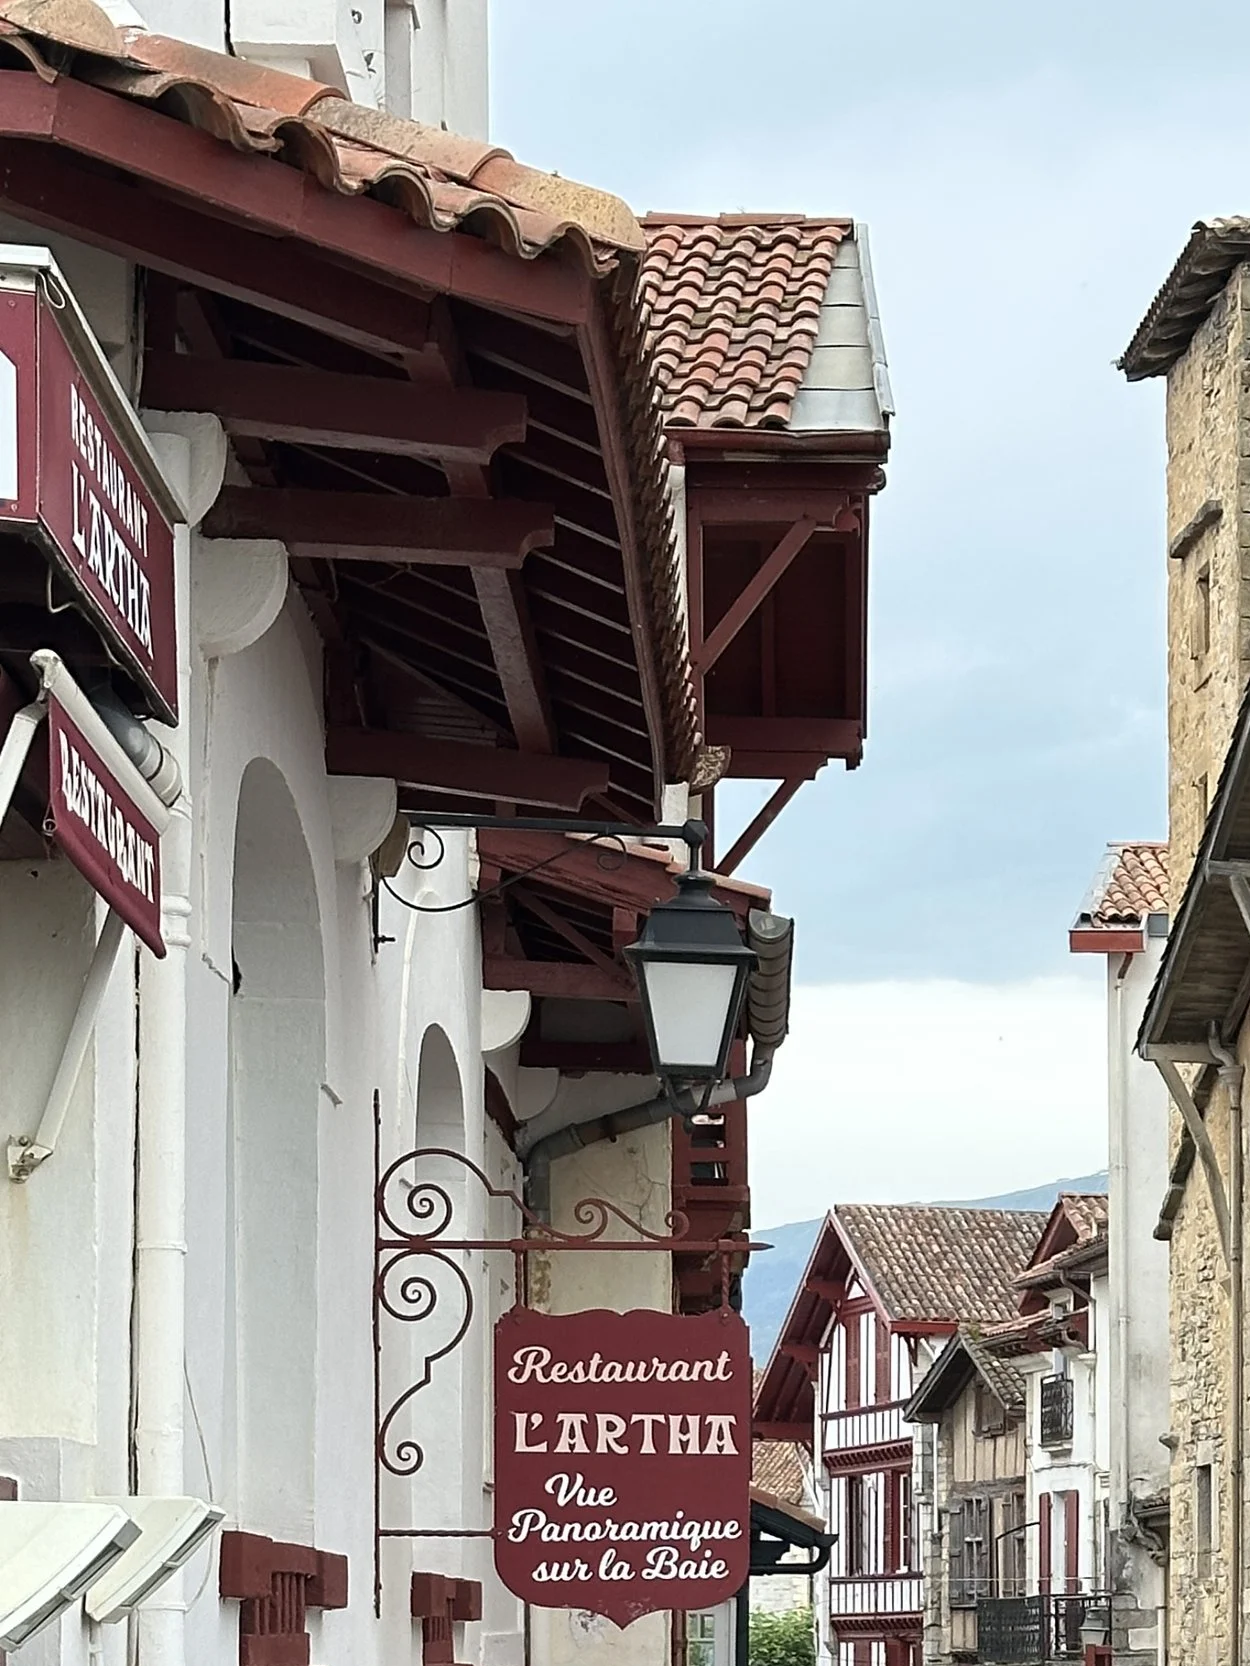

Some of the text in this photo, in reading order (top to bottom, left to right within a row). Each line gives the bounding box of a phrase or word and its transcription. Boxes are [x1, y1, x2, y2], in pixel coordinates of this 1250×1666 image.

[70, 383, 149, 558] RESTAURANT
[71, 460, 154, 661] L'ARTHA
[59, 728, 155, 904] RESTAURANT
[507, 1345, 733, 1384] Restaurant
[514, 1412, 739, 1455] L'ARTHA
[544, 1472, 618, 1507] Vue
[507, 1508, 742, 1551] Panoramique
[531, 1546, 730, 1582] sur la Baie
